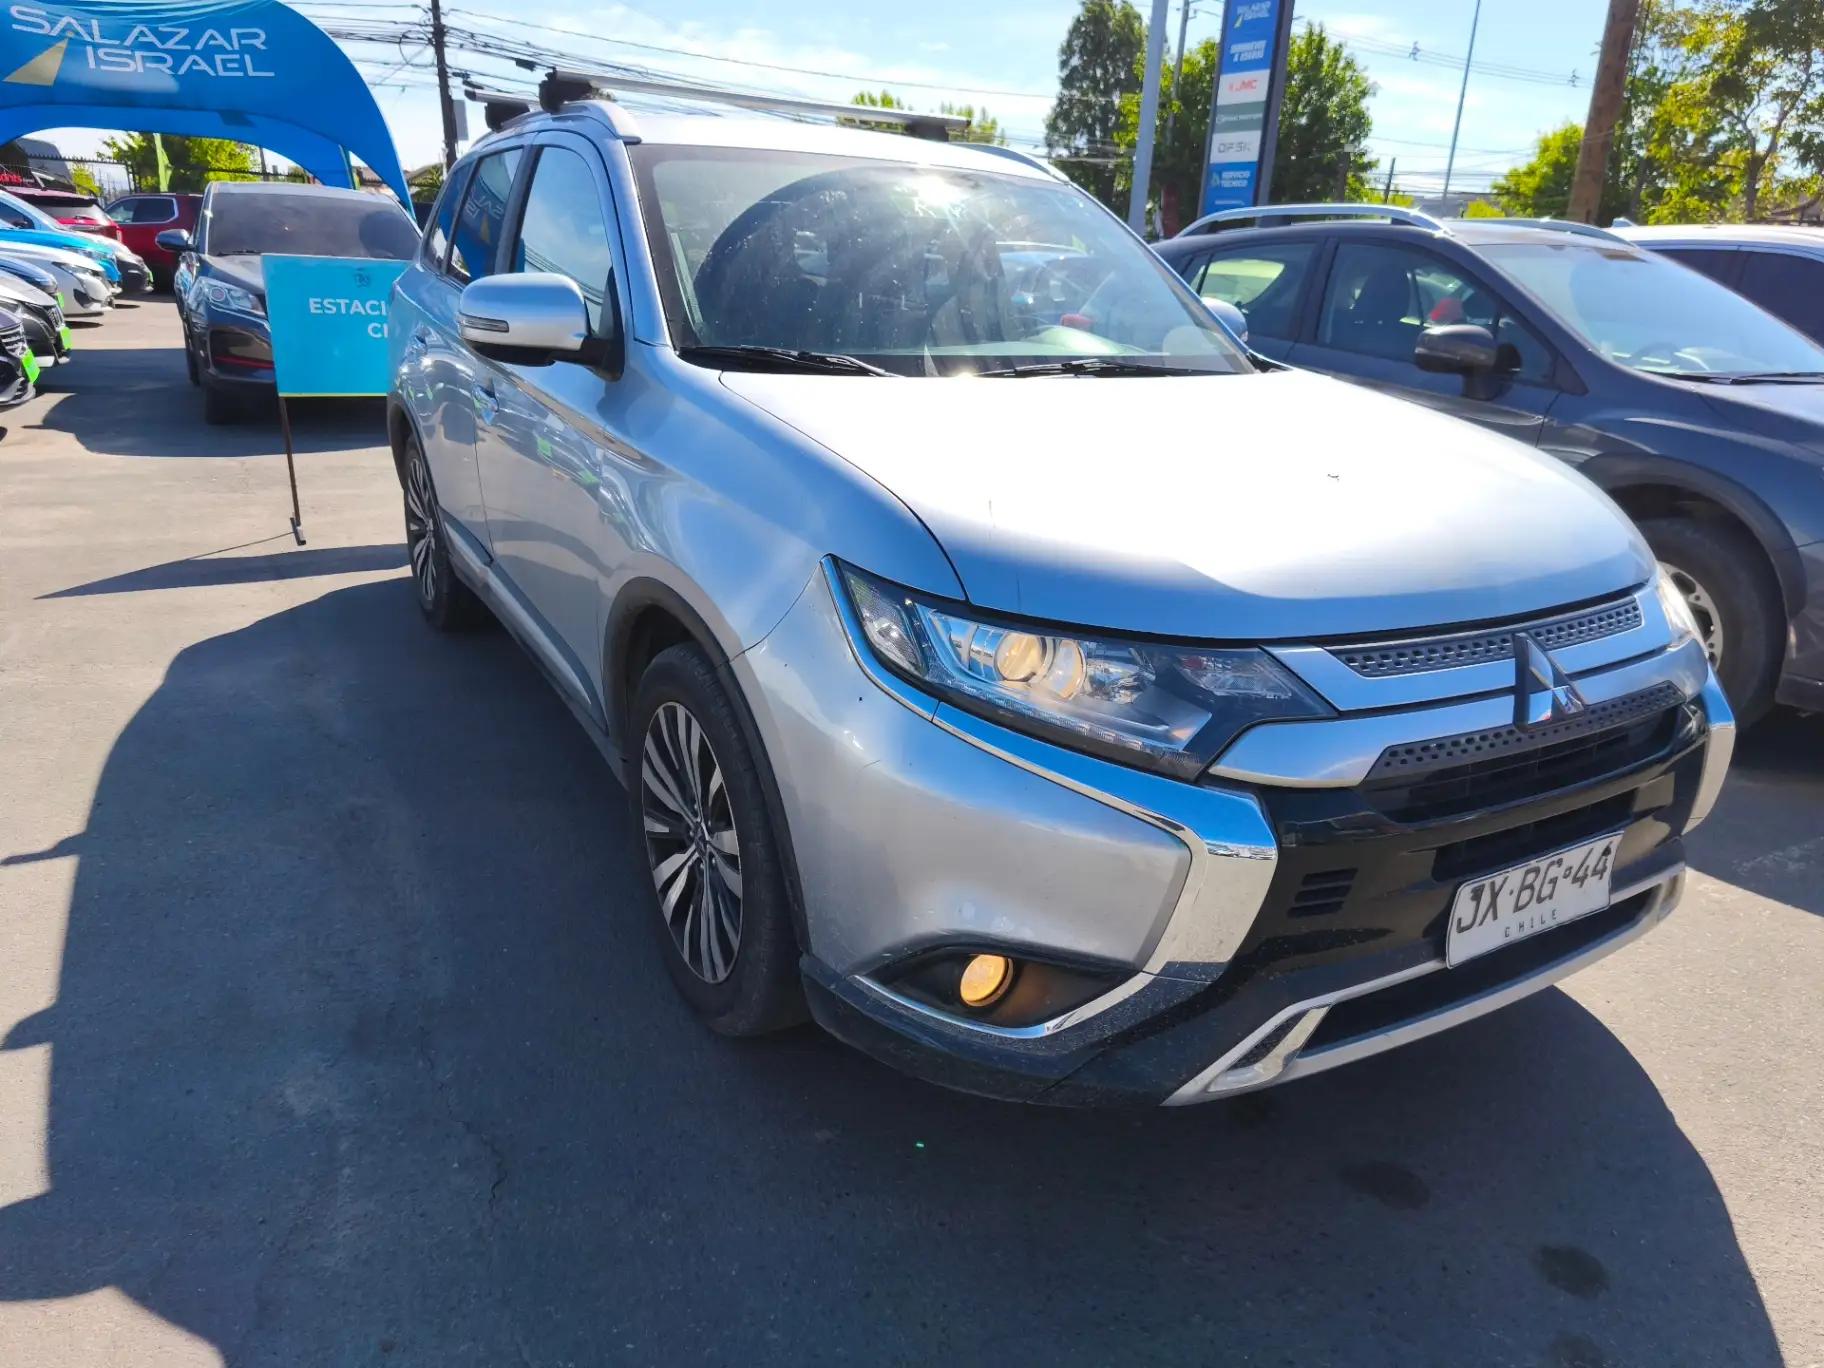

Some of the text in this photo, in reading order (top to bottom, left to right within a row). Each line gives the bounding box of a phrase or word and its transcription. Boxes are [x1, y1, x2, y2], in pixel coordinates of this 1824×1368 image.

[10, 4, 268, 50] SALAZAR
[86, 45, 275, 77] ISRAEL
[309, 297, 387, 316] ESTACI
[1504, 908, 1558, 938] CHILE
